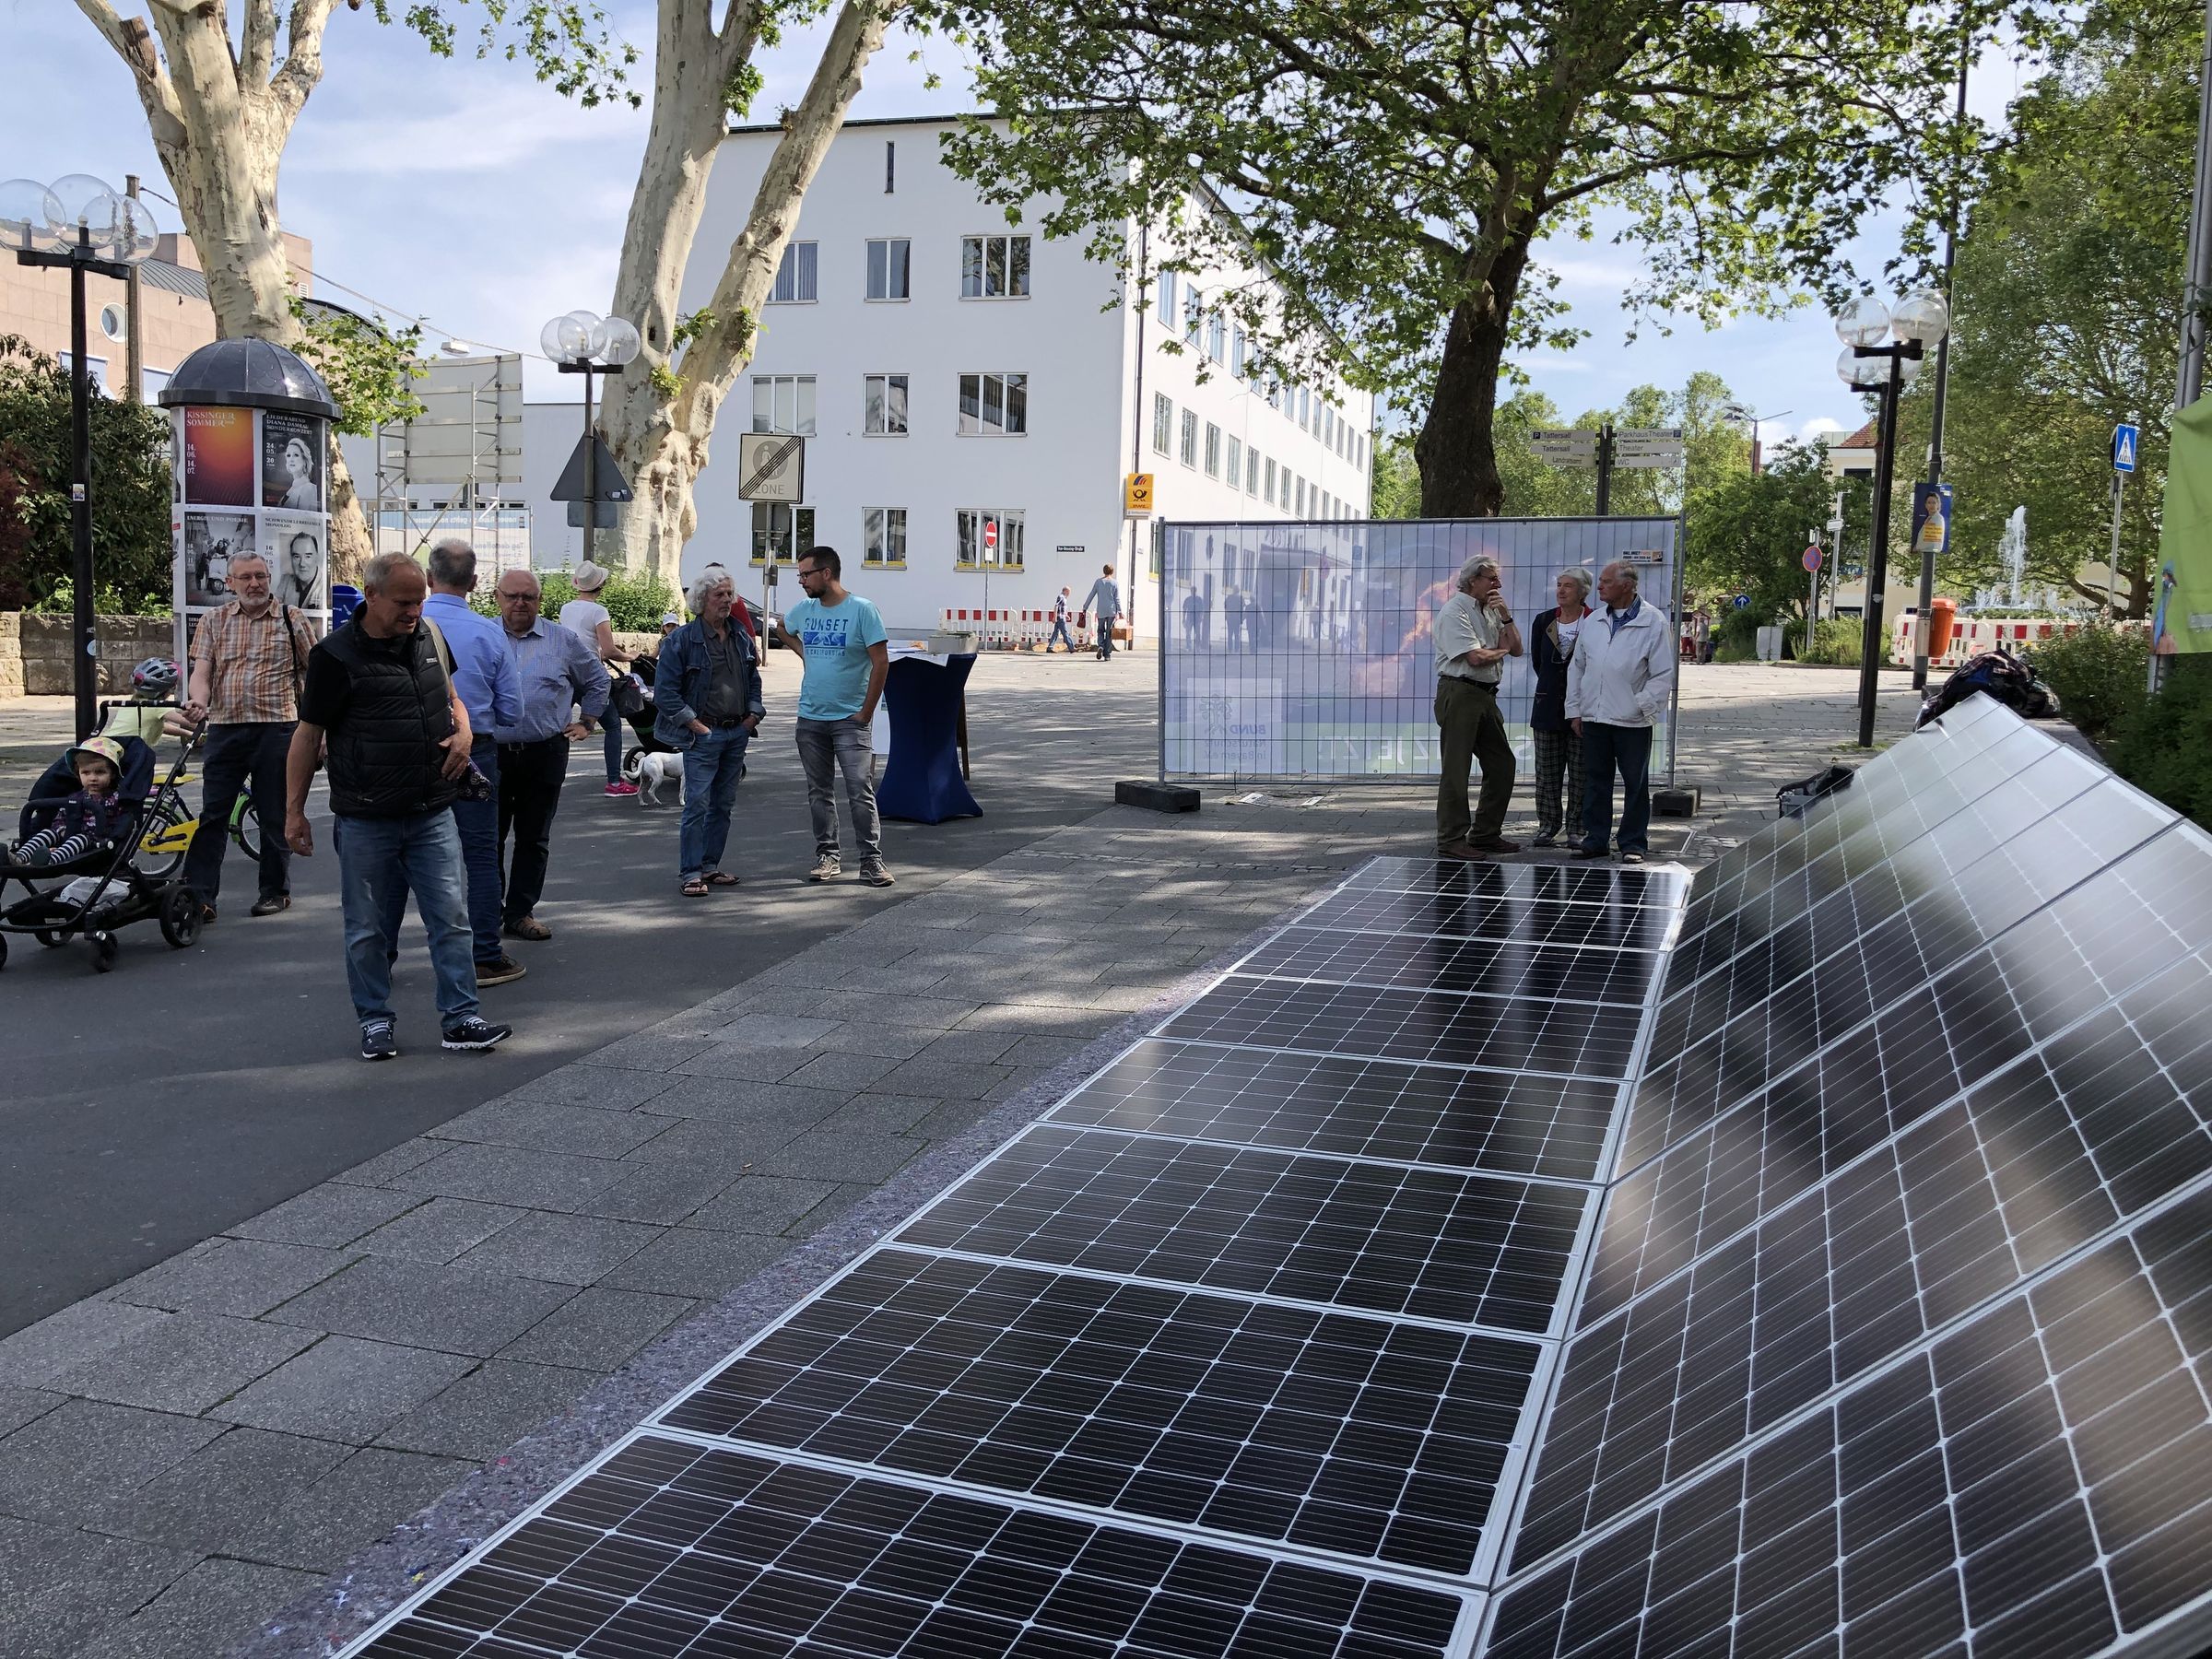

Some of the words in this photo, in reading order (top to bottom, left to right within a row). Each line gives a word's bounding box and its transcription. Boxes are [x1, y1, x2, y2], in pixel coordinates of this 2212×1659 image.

[187, 411, 236, 420] KISSINGER
[186, 419, 225, 428] SOMMER
[187, 443, 196, 452] 14.
[755, 484, 785, 495] ZONE
[805, 618, 849, 632] SUNSET
